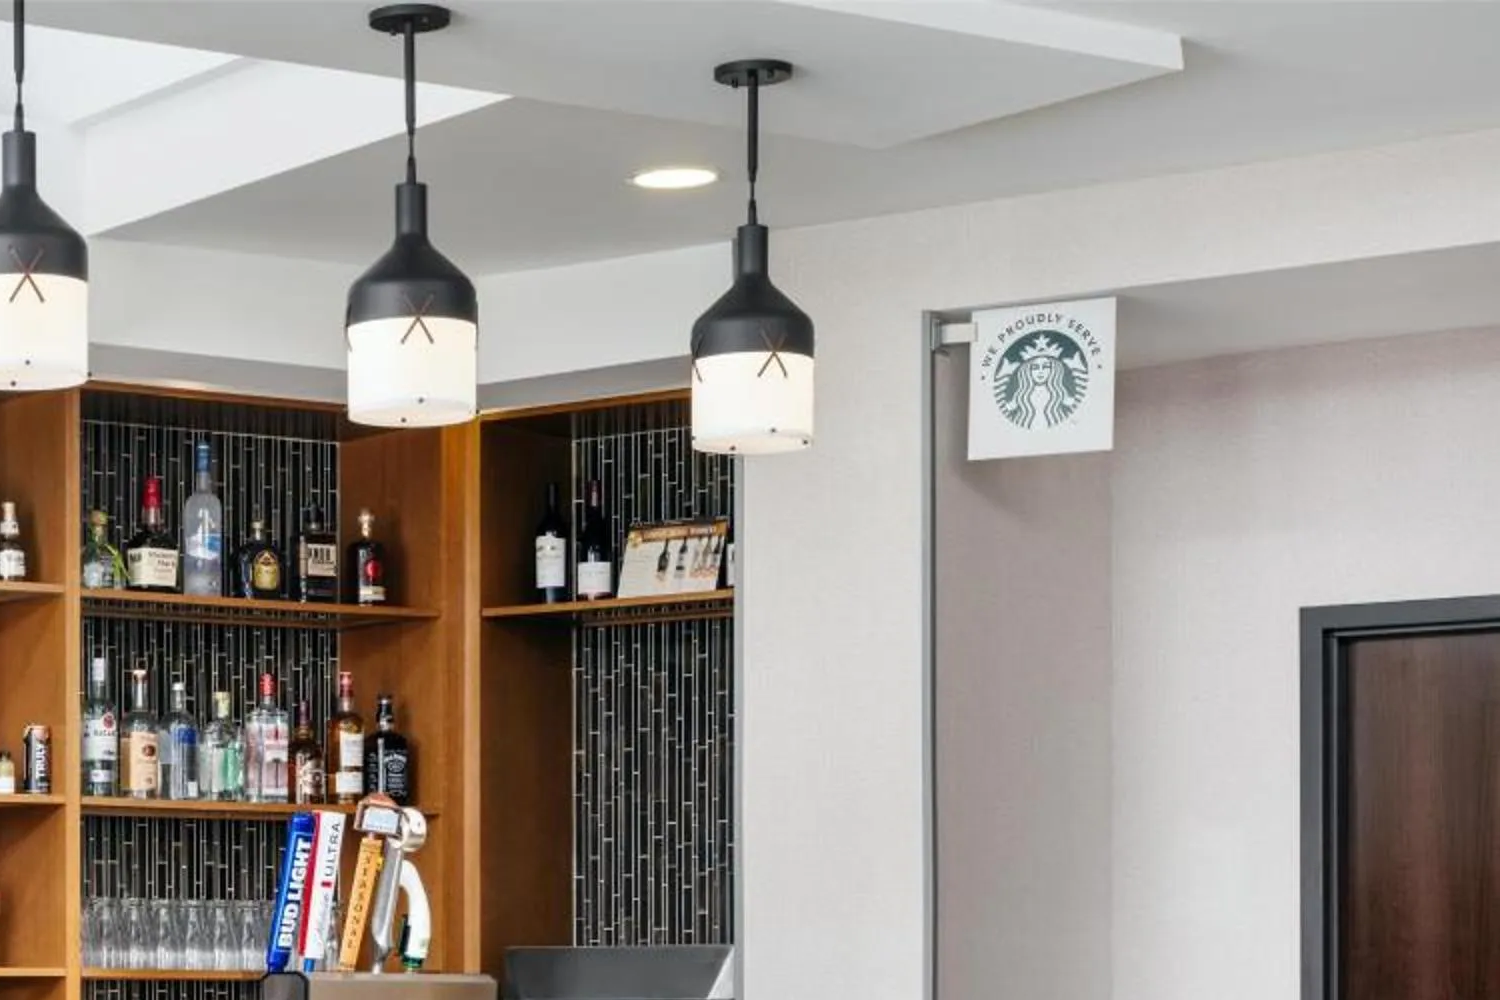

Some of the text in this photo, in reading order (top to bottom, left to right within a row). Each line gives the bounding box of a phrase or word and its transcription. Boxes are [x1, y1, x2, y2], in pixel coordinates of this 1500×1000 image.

[981, 312, 1101, 368] WE PROUDLY SERVE
[323, 821, 341, 877] ULTRA
[277, 838, 312, 947] BUD LIGHT
